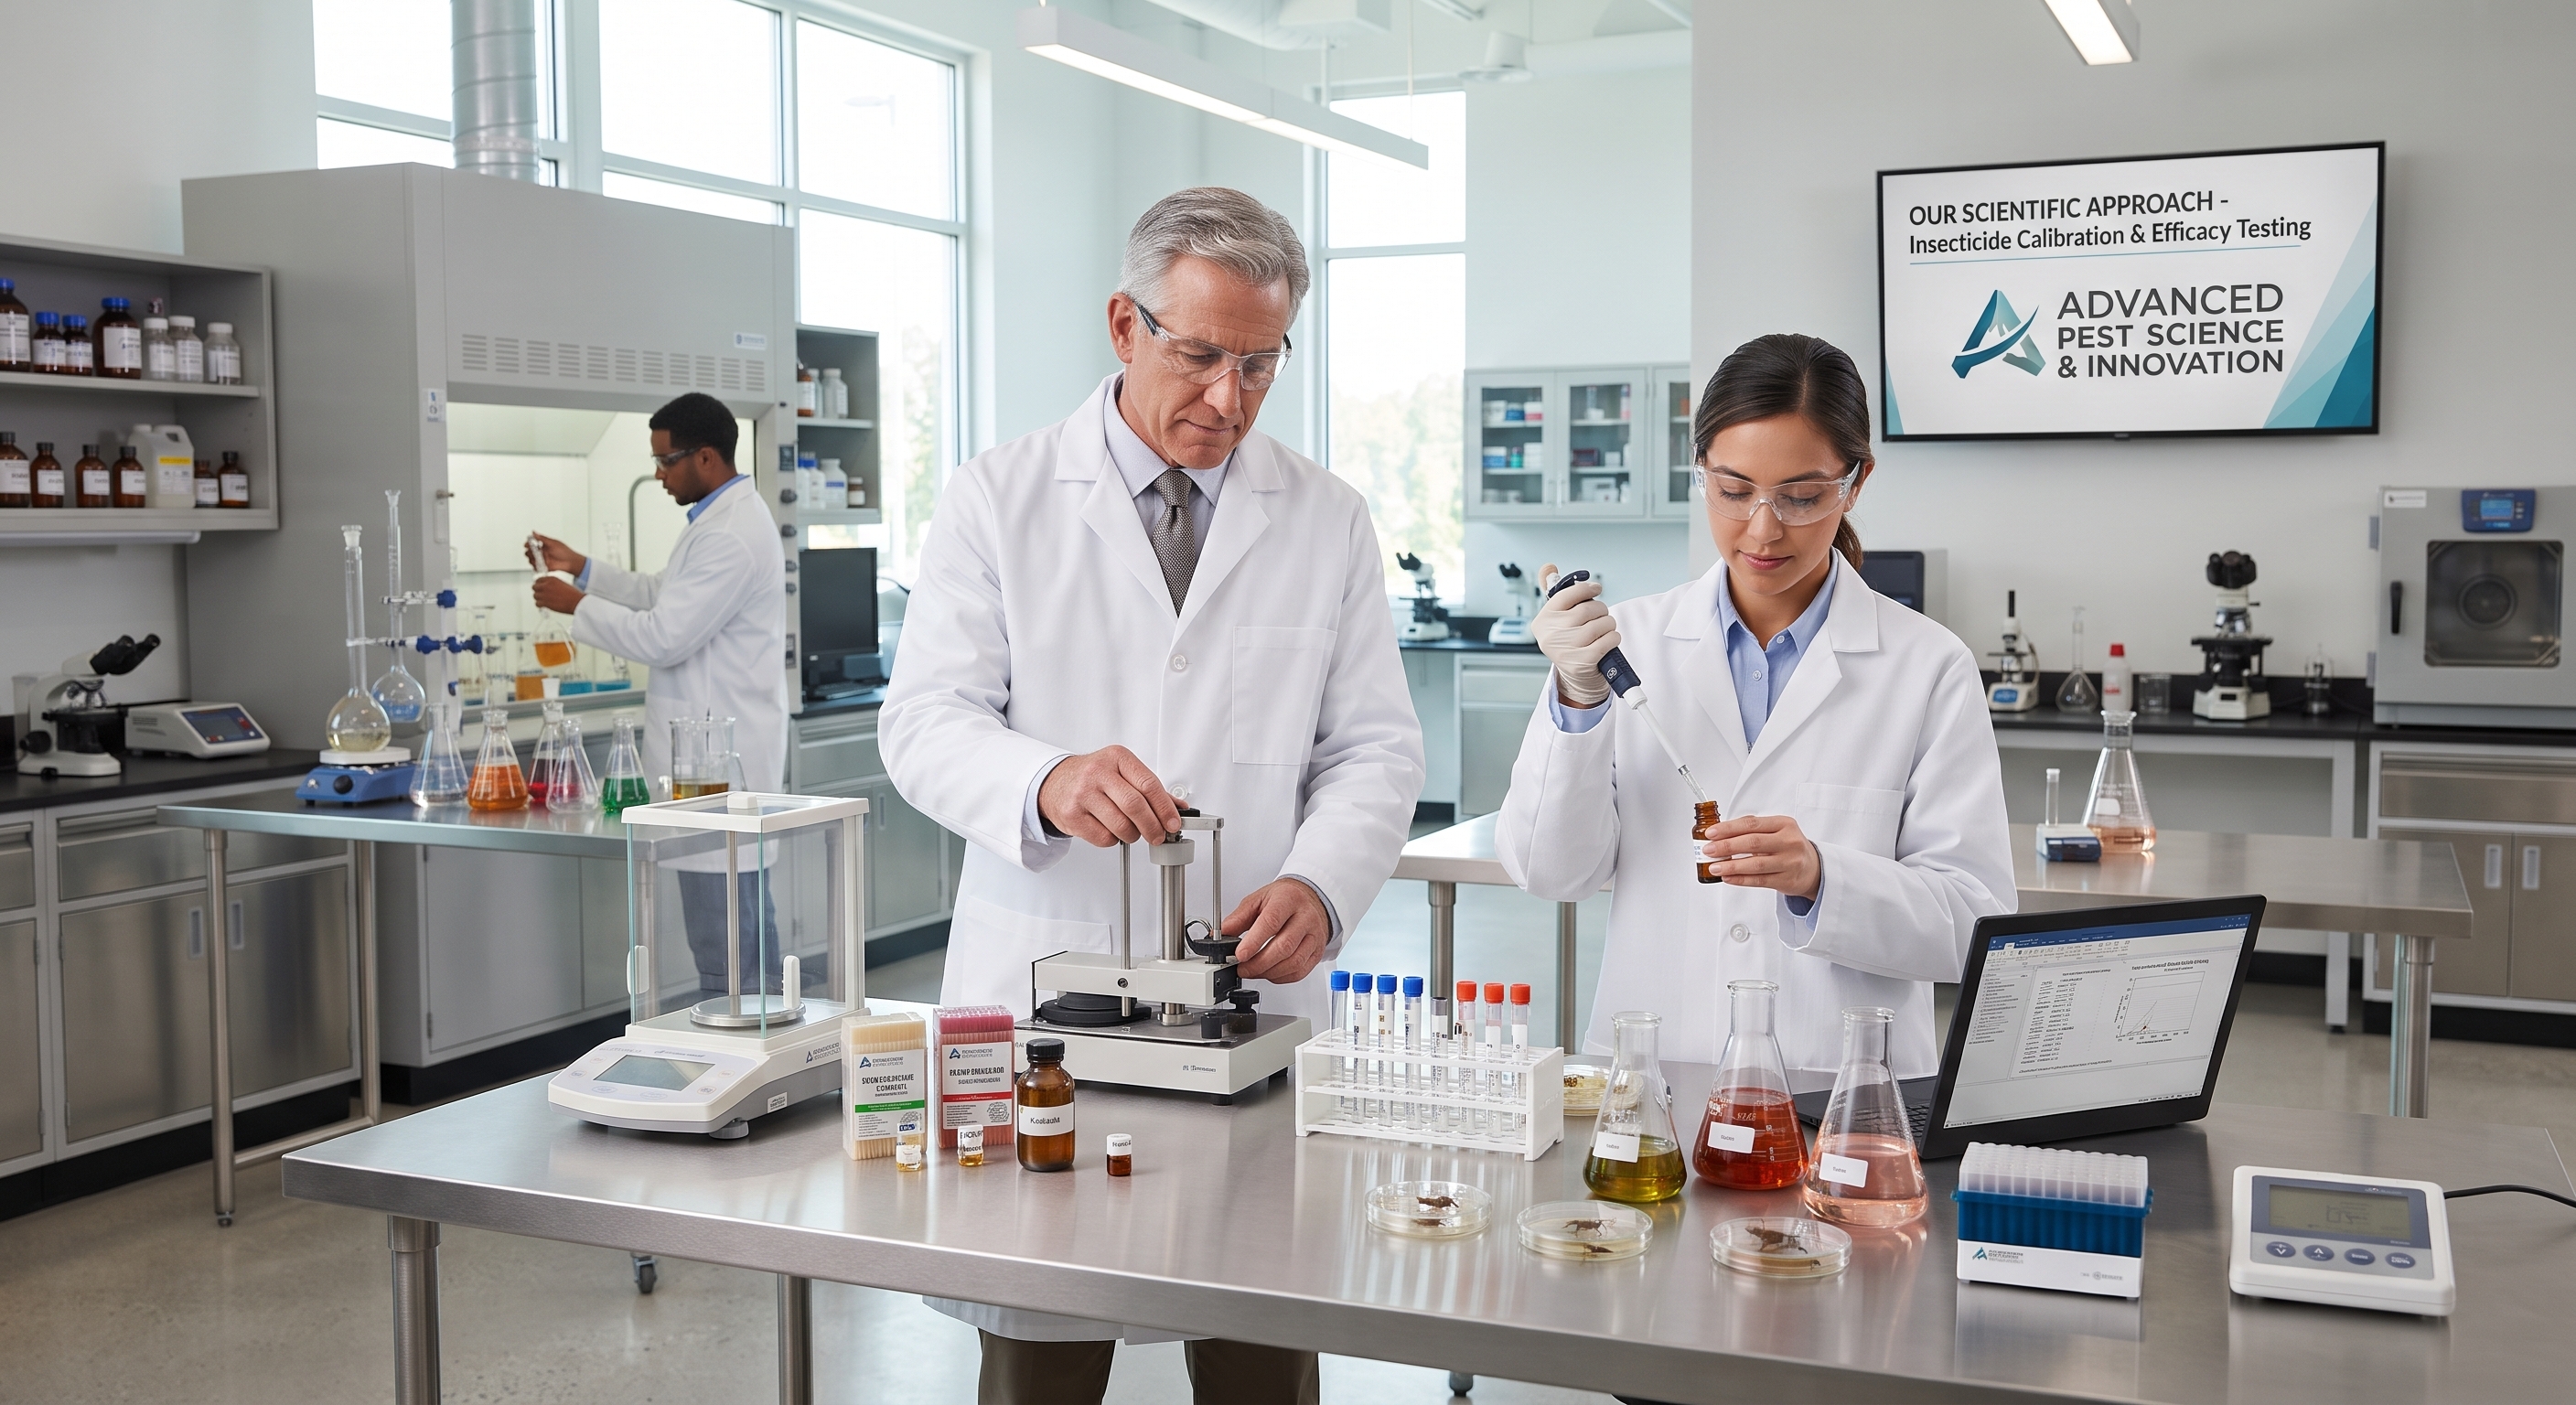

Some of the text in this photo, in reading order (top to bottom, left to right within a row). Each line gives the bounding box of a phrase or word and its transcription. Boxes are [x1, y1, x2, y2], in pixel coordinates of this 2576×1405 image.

[1909, 204, 1958, 226] OUR
[1961, 197, 2081, 224] SCIENTIFIC
[2086, 190, 2213, 218] APPROACH
[1910, 217, 2312, 254] Insecticide Calibration & Efficacy Testing
[2057, 283, 2283, 320] ADVANCED
[2058, 319, 2284, 350] PEST SCIENCE
[2057, 349, 2283, 379] & INNOVATION
